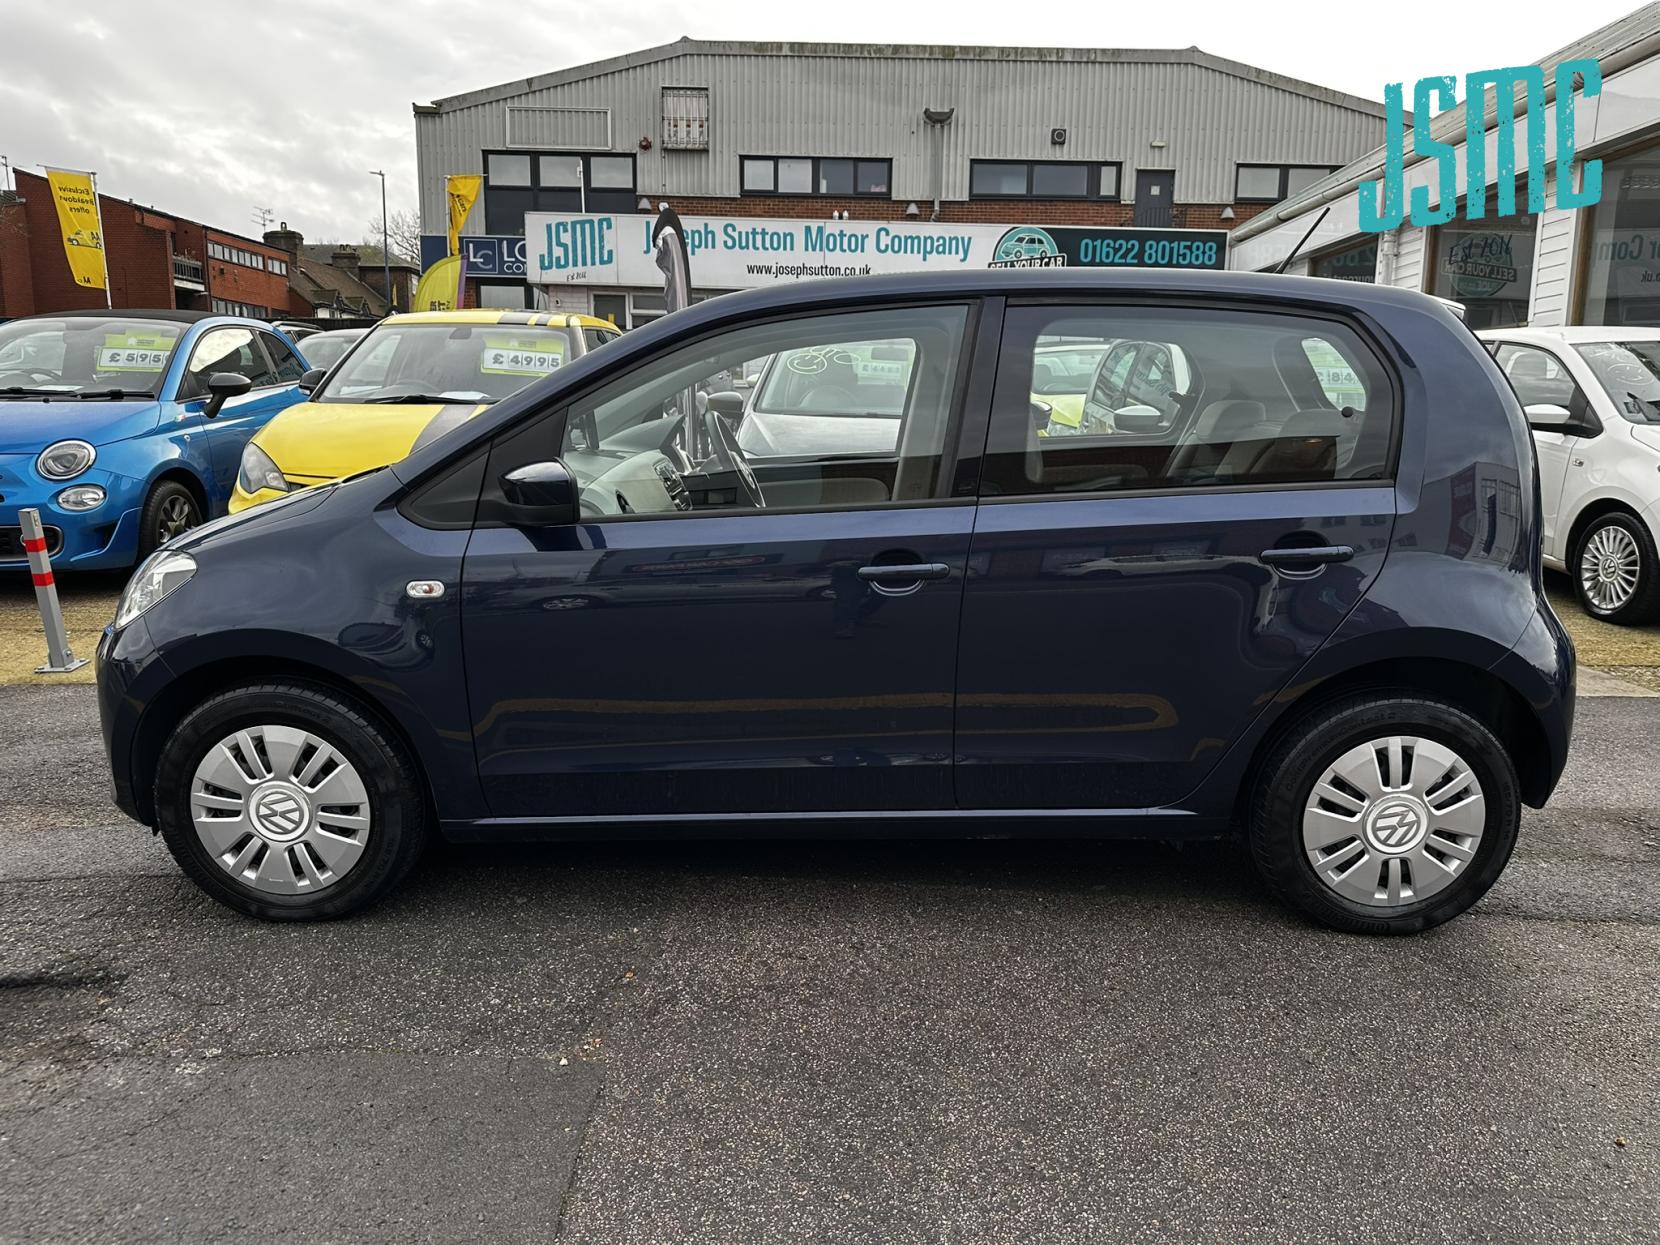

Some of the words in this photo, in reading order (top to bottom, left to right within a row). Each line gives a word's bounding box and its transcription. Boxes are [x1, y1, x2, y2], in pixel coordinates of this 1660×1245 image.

[538, 216, 614, 271] JSMC
[722, 222, 795, 252] Sutton
[803, 224, 869, 253] Motor
[875, 227, 972, 262] Company
[1079, 238, 1139, 263] 01622
[1143, 240, 1217, 265] 801588
